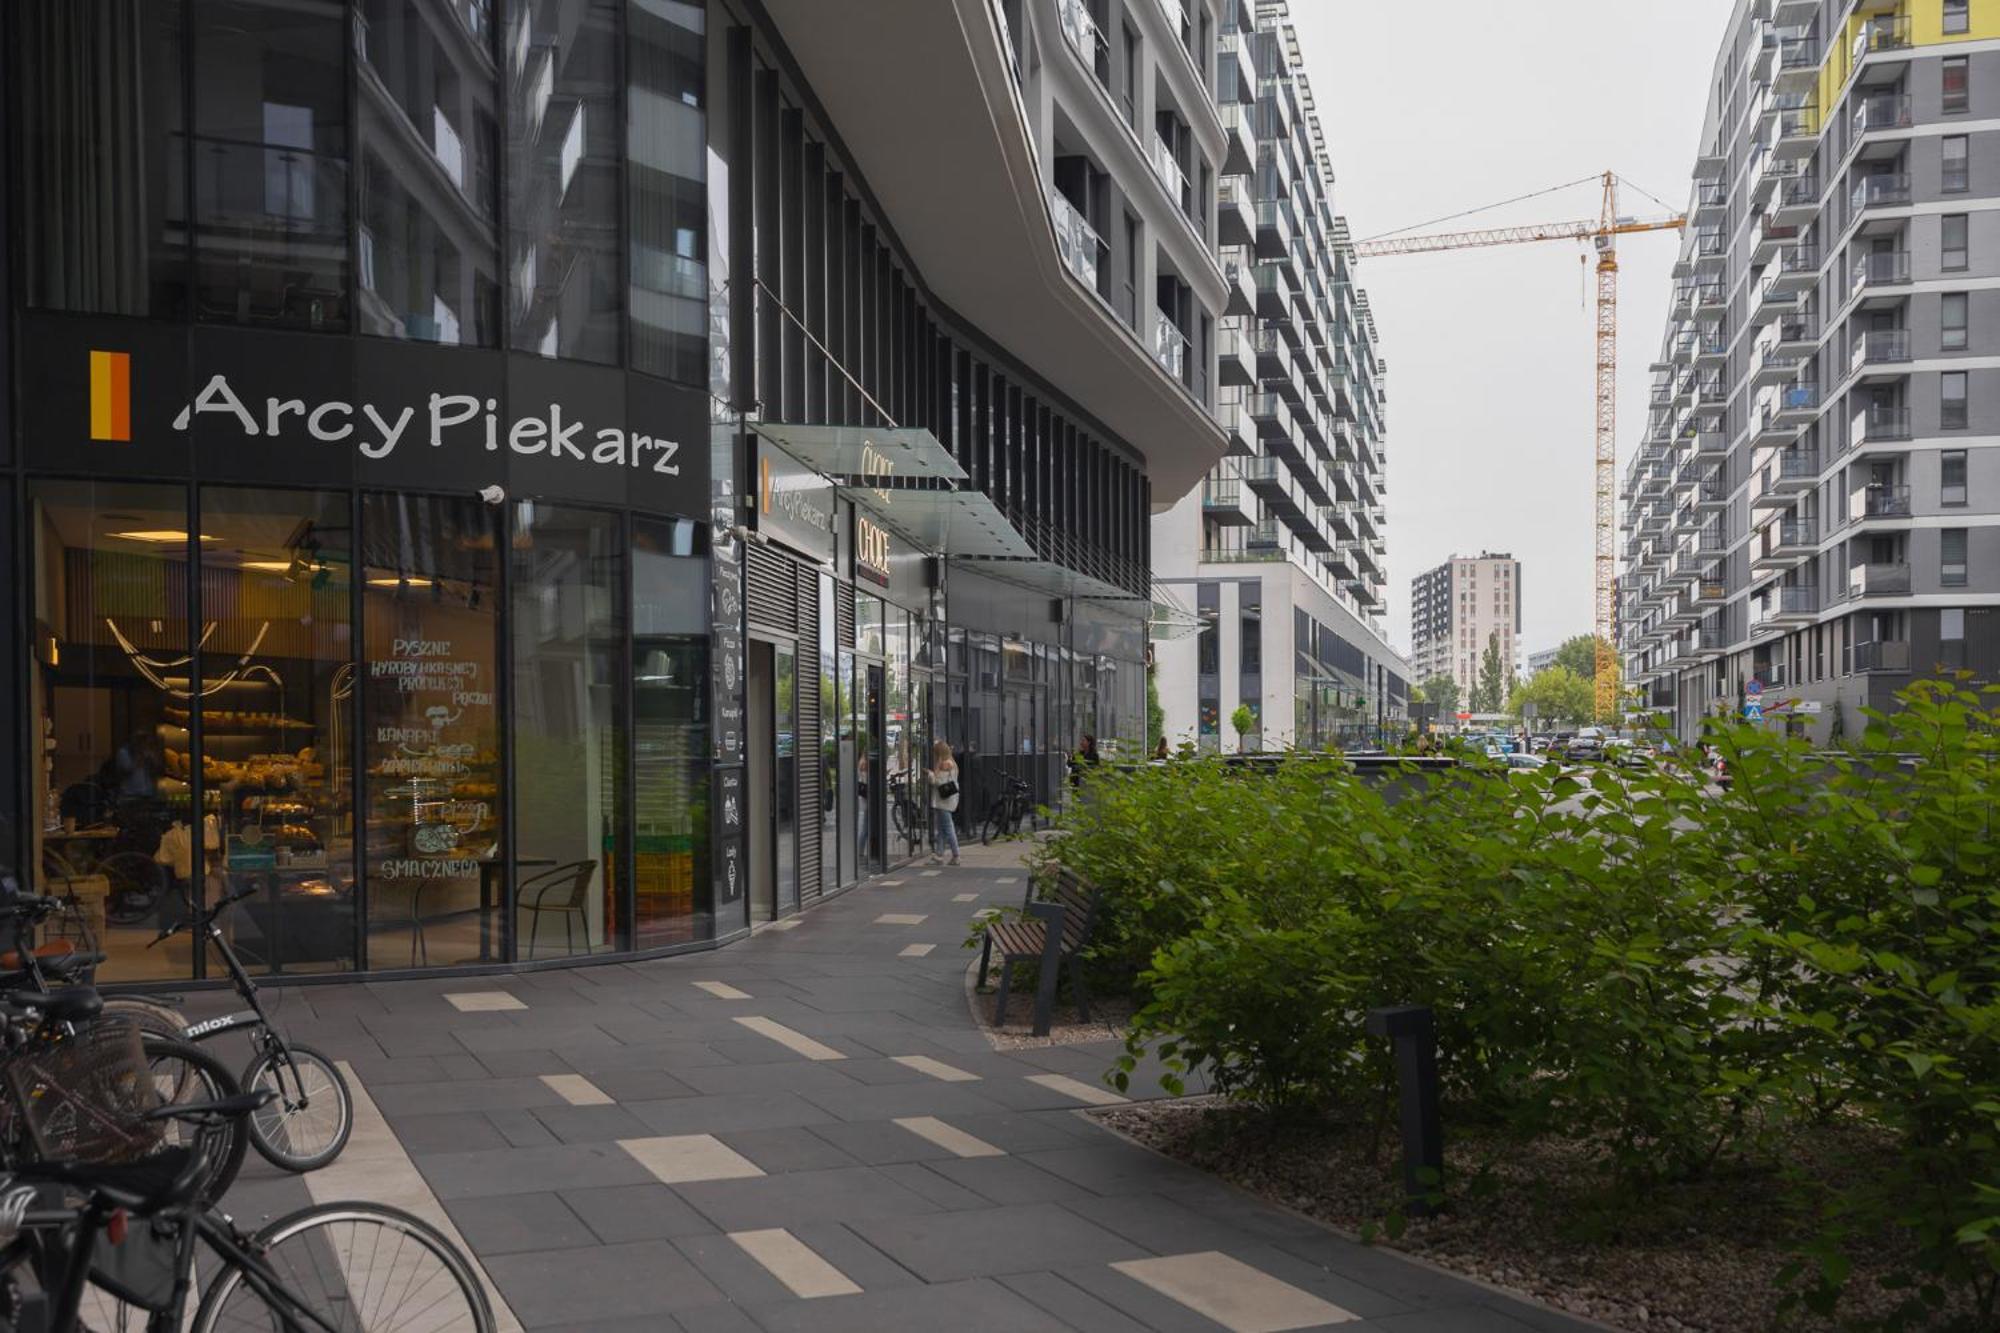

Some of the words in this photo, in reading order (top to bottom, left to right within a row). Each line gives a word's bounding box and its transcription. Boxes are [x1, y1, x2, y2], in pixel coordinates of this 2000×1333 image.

[858, 517, 891, 575] CHOICE
[392, 639, 452, 657] PYSZNE
[381, 860, 479, 880] SMACZNEGO
[186, 1015, 236, 1038] nilox
